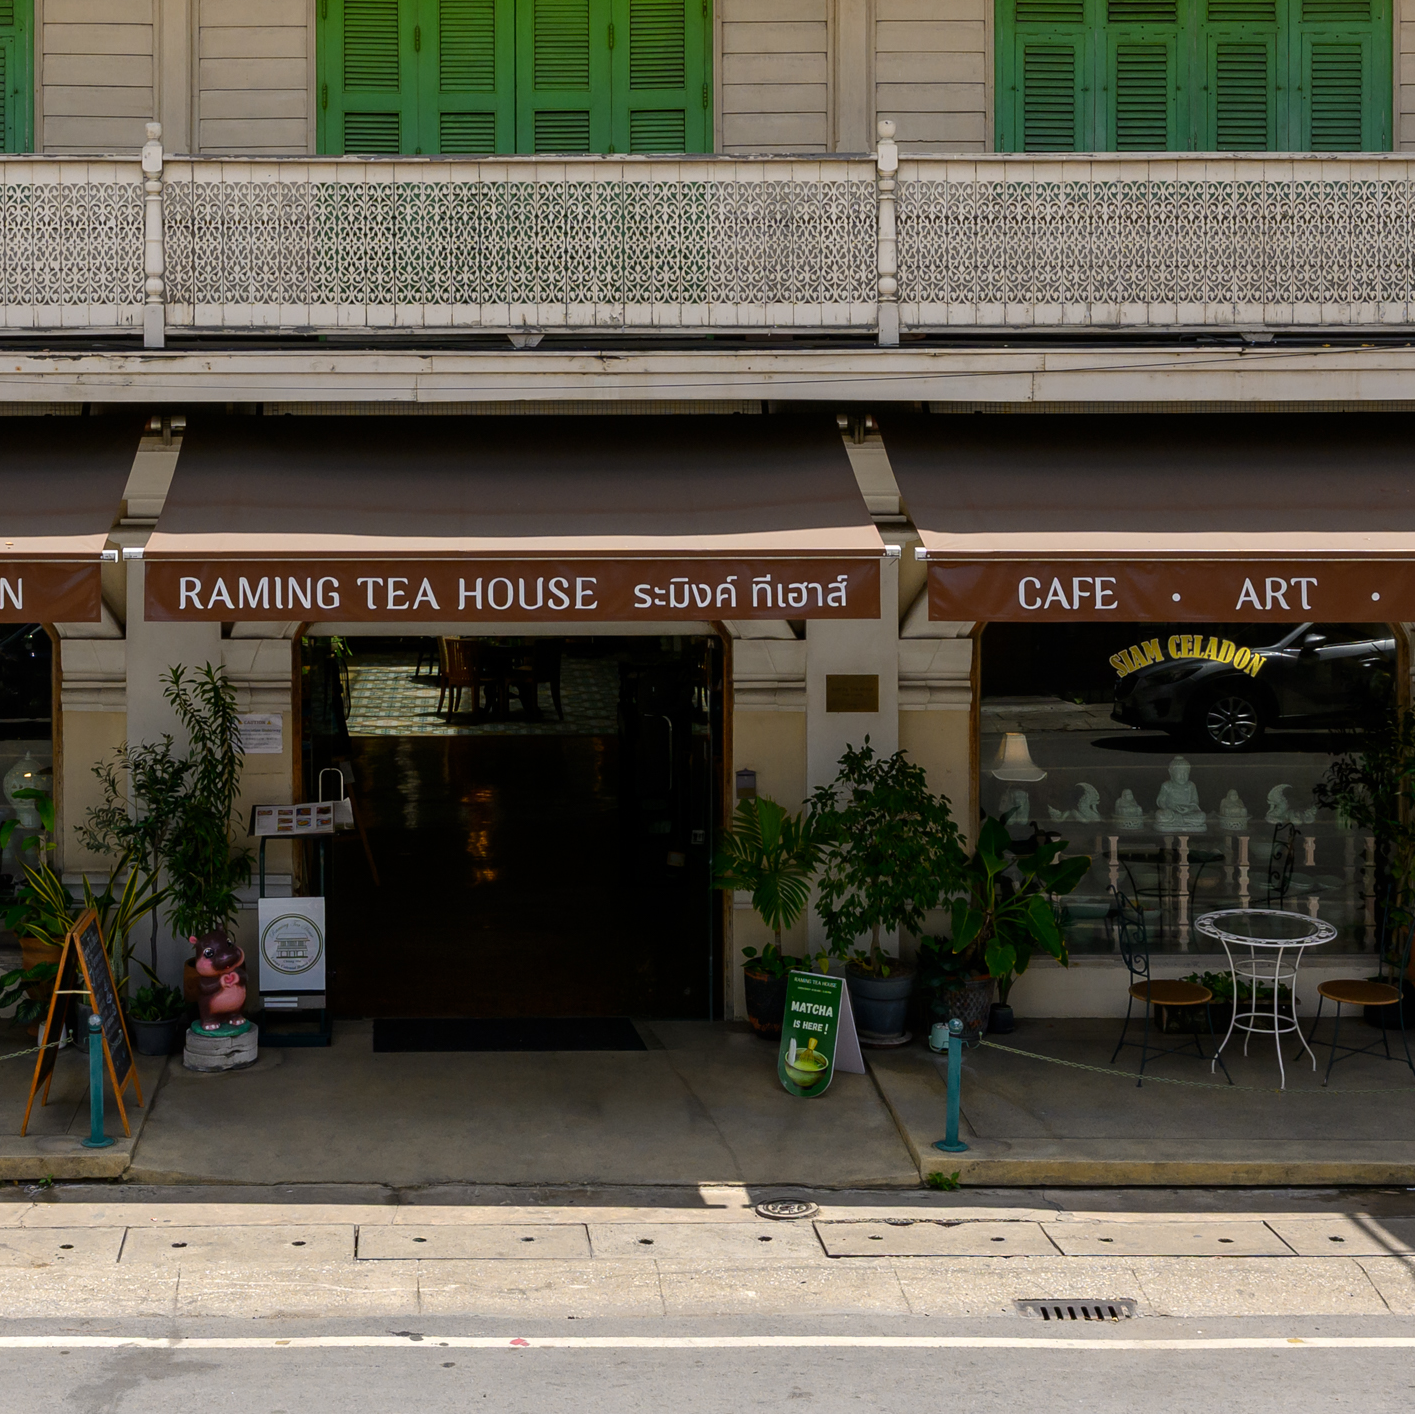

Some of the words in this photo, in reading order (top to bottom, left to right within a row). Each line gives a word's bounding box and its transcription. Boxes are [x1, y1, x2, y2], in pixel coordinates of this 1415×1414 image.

[178, 576, 340, 610] RAMING
[356, 577, 441, 610] TEA
[458, 577, 598, 610] HOUSE
[633, 574, 738, 609] ระมิงค์
[751, 573, 848, 608] ทีเฮาส์
[1018, 576, 1118, 610] CAFE
[1235, 577, 1318, 610] ART
[1108, 637, 1165, 678] SIAM
[1167, 635, 1268, 678] CELADON
[794, 976, 812, 984] RAMING
[791, 1000, 833, 1018] MATCHA
[793, 1019, 801, 1028] IS
